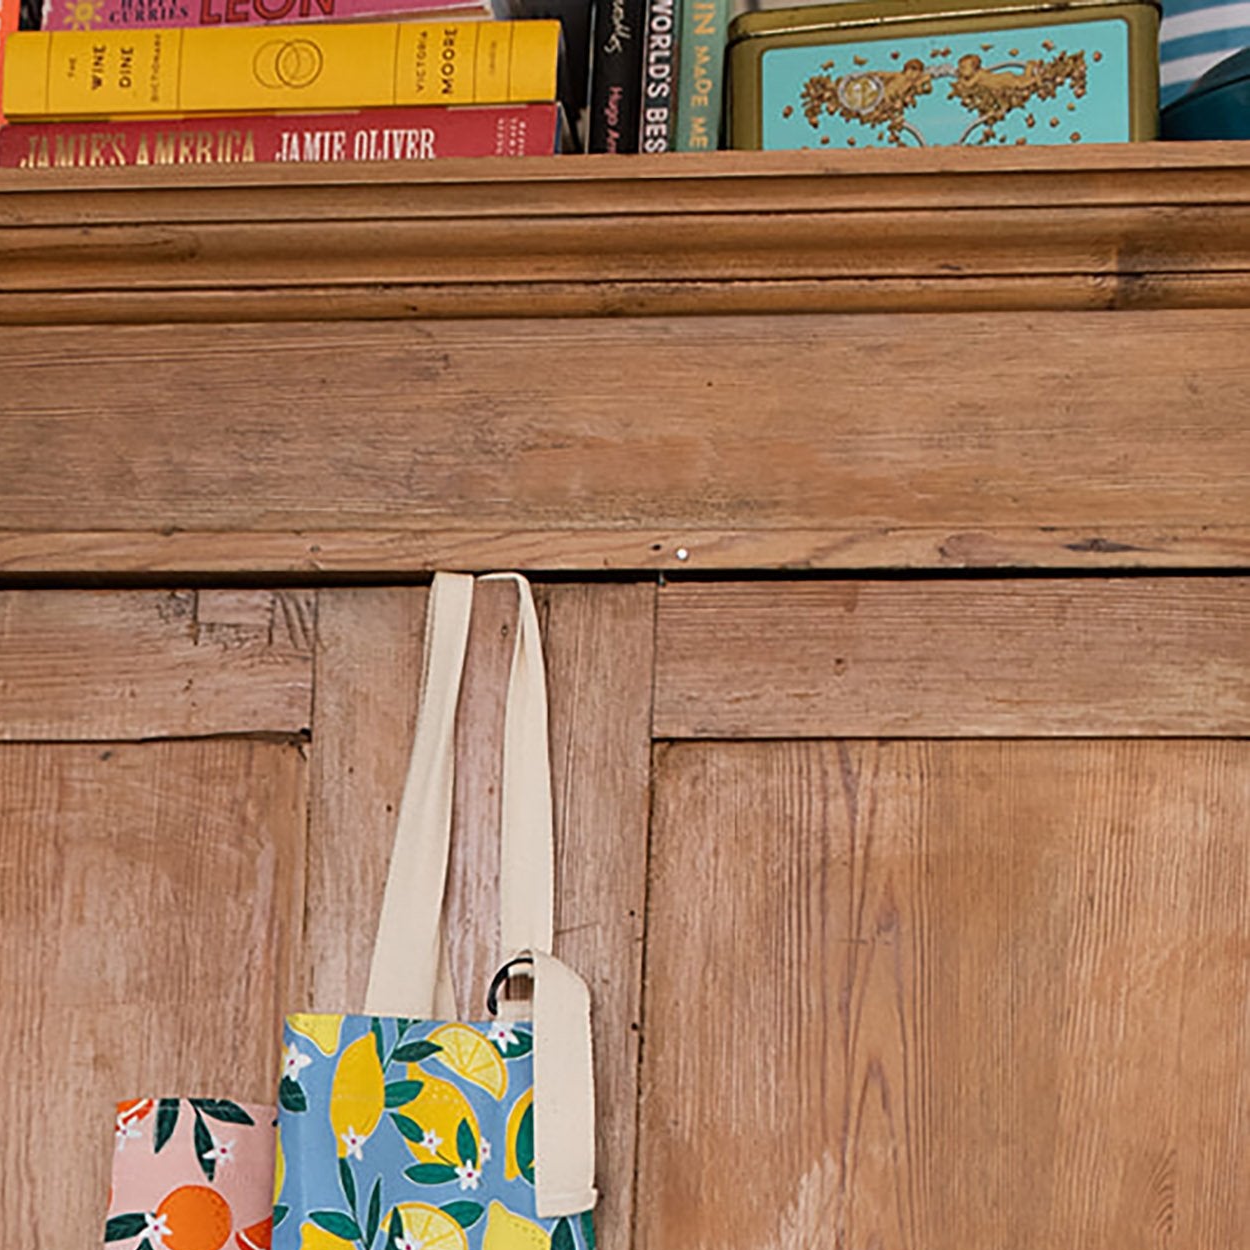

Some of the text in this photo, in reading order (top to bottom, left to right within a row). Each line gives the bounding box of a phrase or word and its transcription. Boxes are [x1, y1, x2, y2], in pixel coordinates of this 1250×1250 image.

[91, 45, 106, 91] WINE
[119, 47, 134, 89] DINE
[416, 30, 428, 93] VICTORIA
[441, 28, 458, 95] MOORE
[19, 128, 436, 168] JAMIE'S AMERICA JAMIE OLIVER
